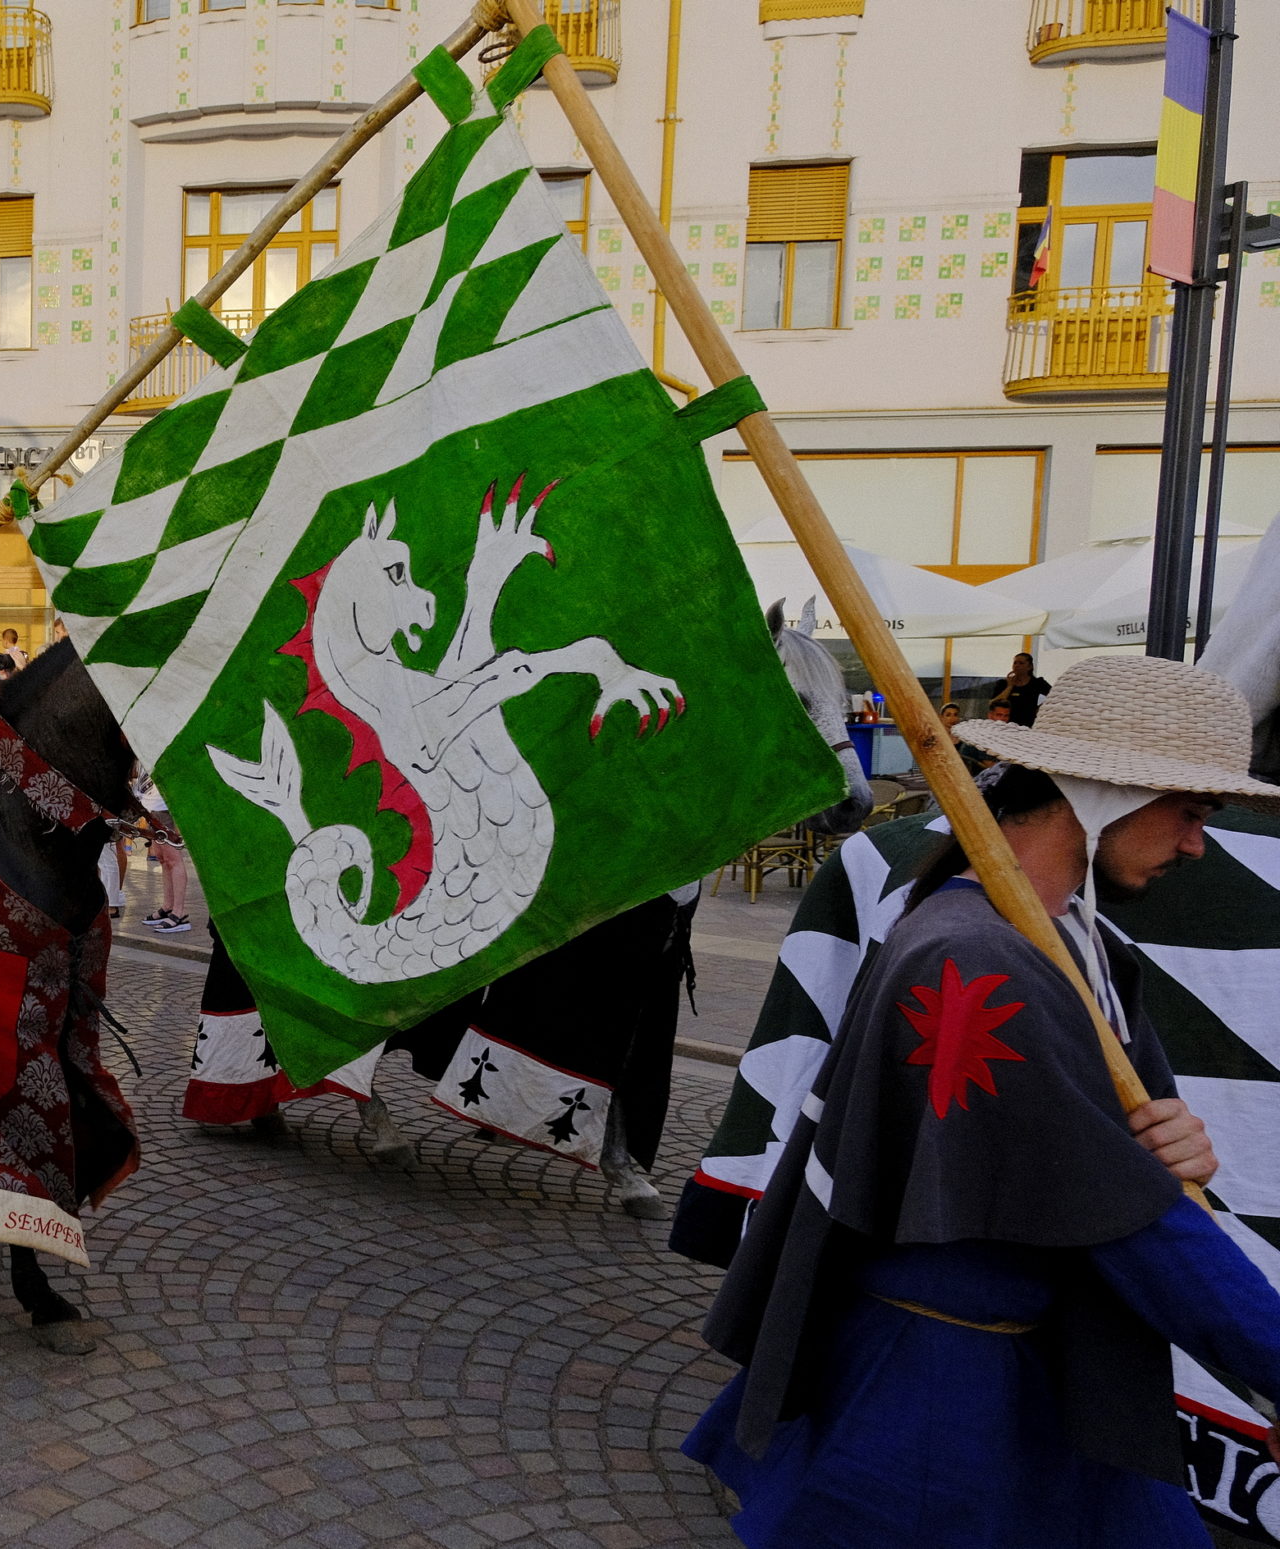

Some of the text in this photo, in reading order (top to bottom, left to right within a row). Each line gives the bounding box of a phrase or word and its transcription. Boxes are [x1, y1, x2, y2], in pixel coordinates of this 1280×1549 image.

[75, 445, 97, 459] BT
[1116, 621, 1146, 637] STELLA
[4, 1211, 86, 1252] SEMPER
